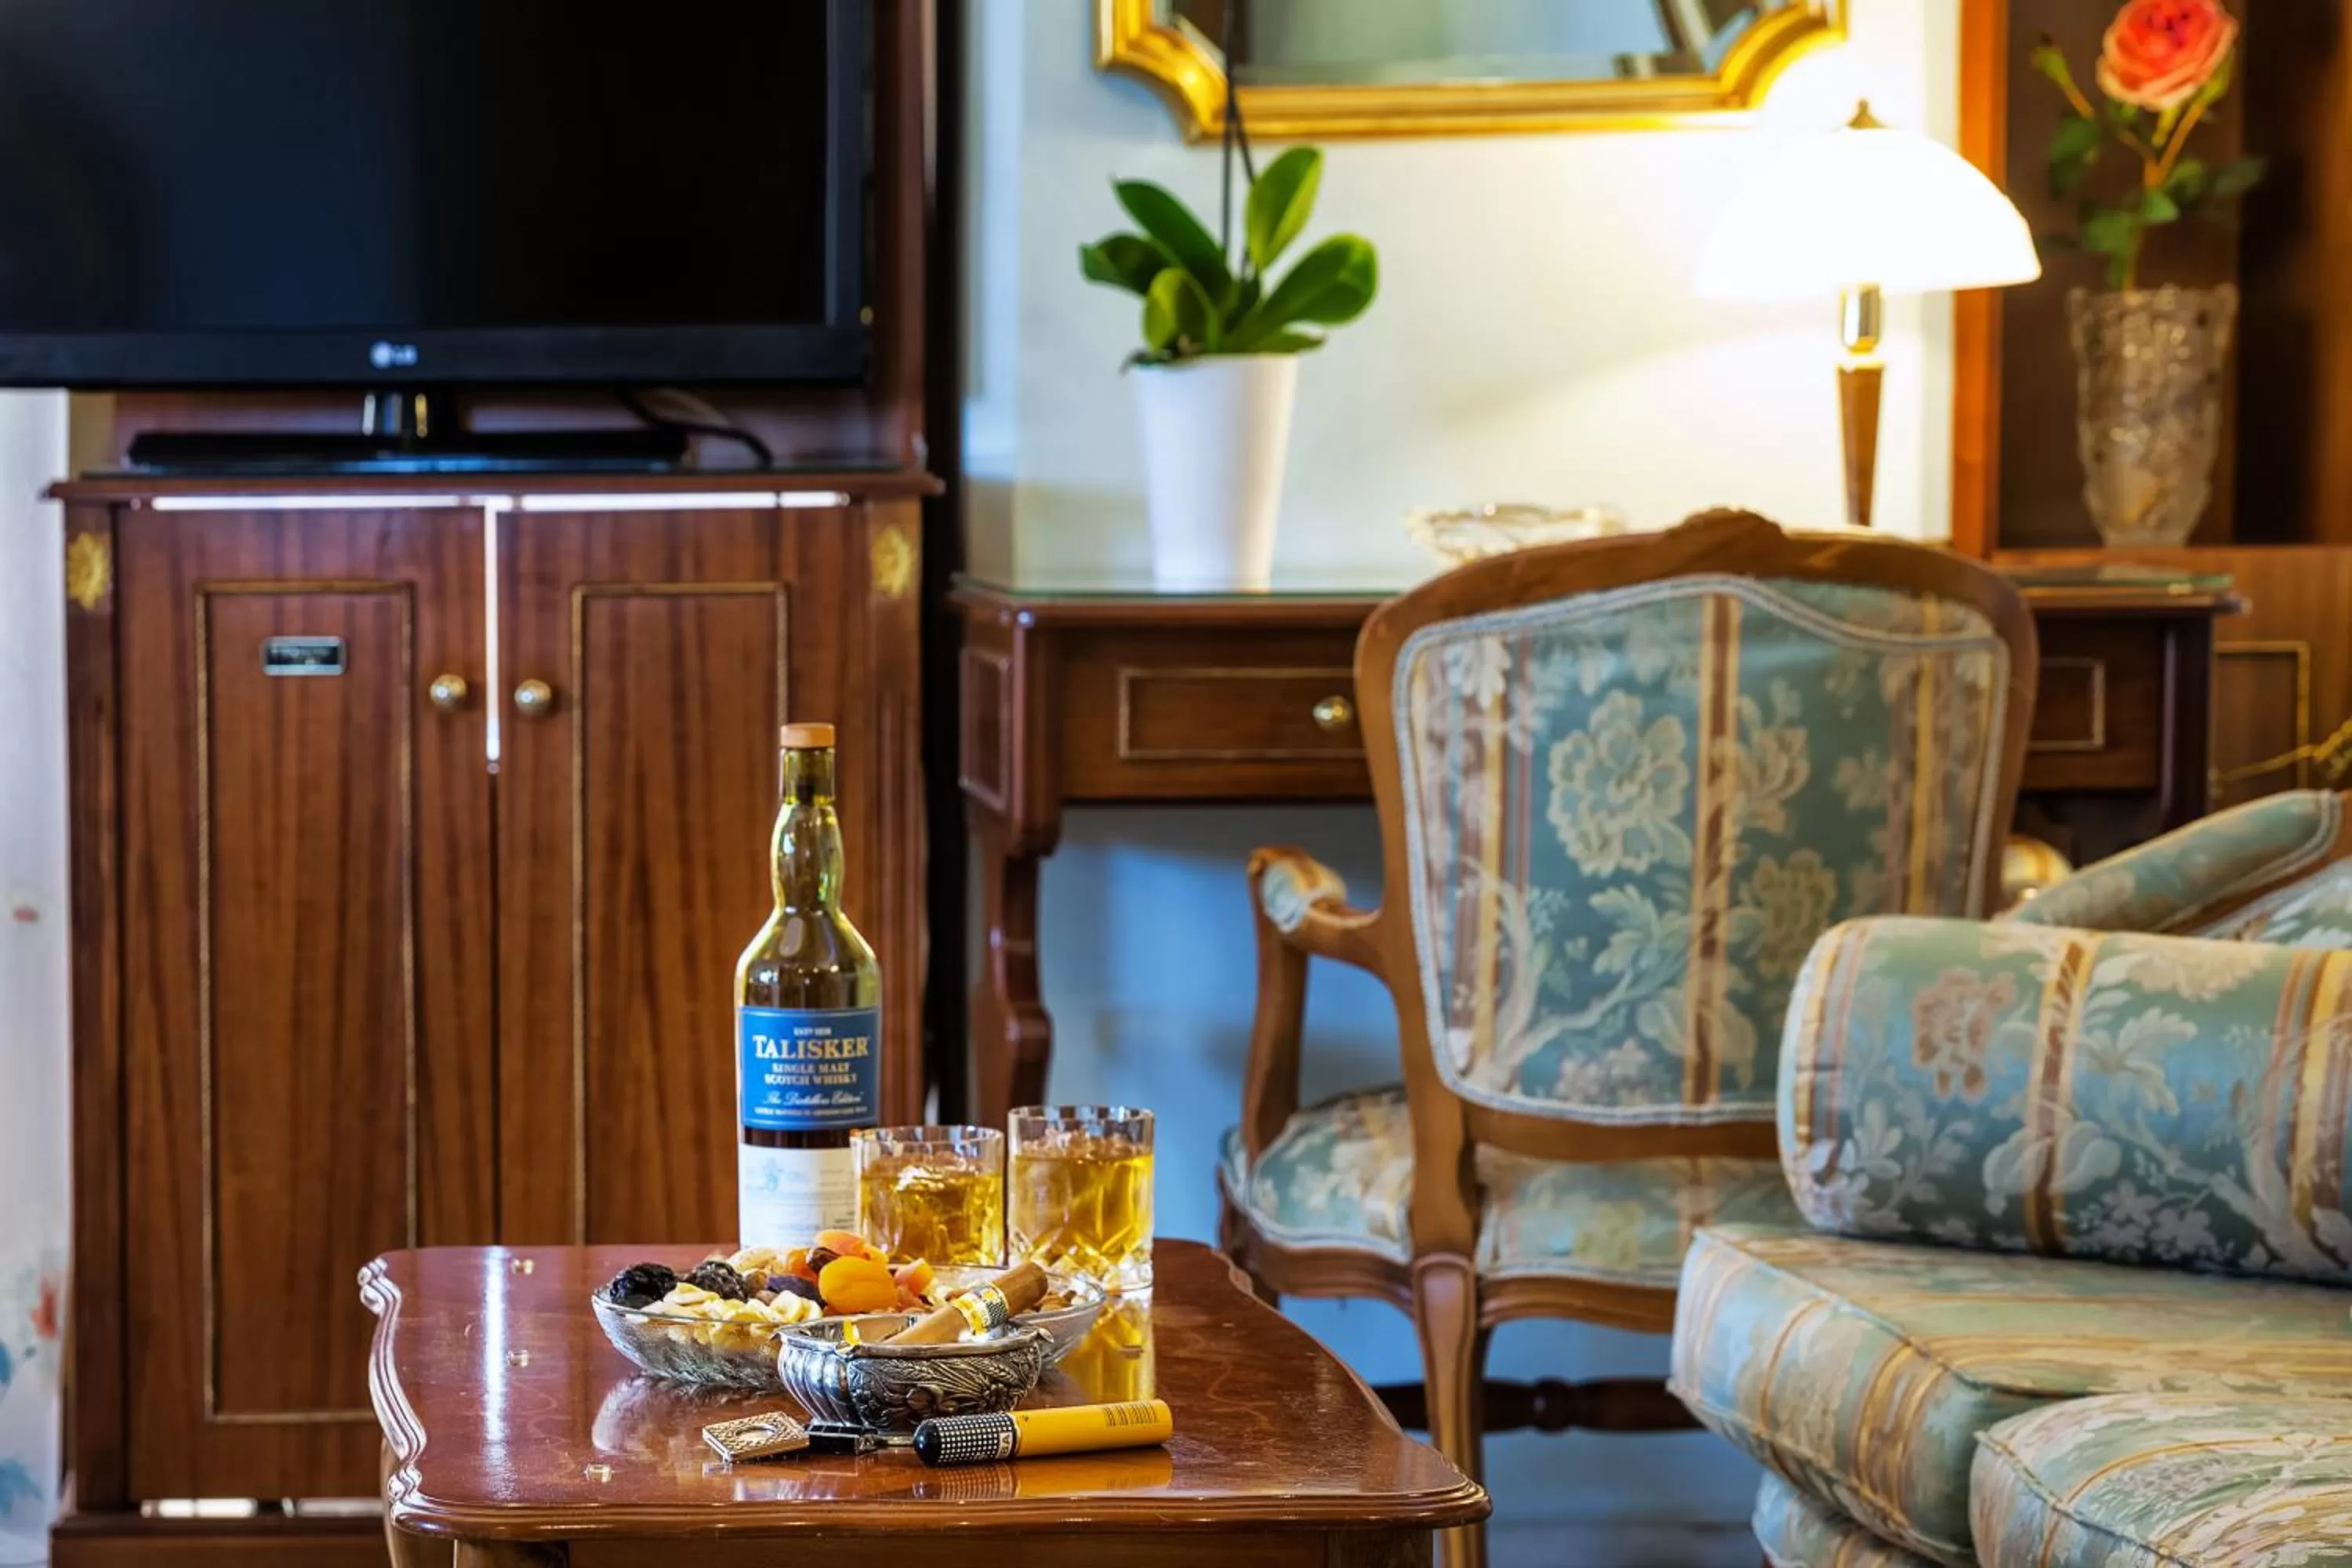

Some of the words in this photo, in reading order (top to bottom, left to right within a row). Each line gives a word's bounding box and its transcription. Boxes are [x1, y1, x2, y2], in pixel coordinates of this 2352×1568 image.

[752, 1035, 869, 1059] TALISKER
[771, 1062, 814, 1073] SINGLE
[818, 1062, 851, 1073] MALT
[764, 1073, 810, 1085] SCOTCH
[812, 1073, 857, 1085] WHISKY
